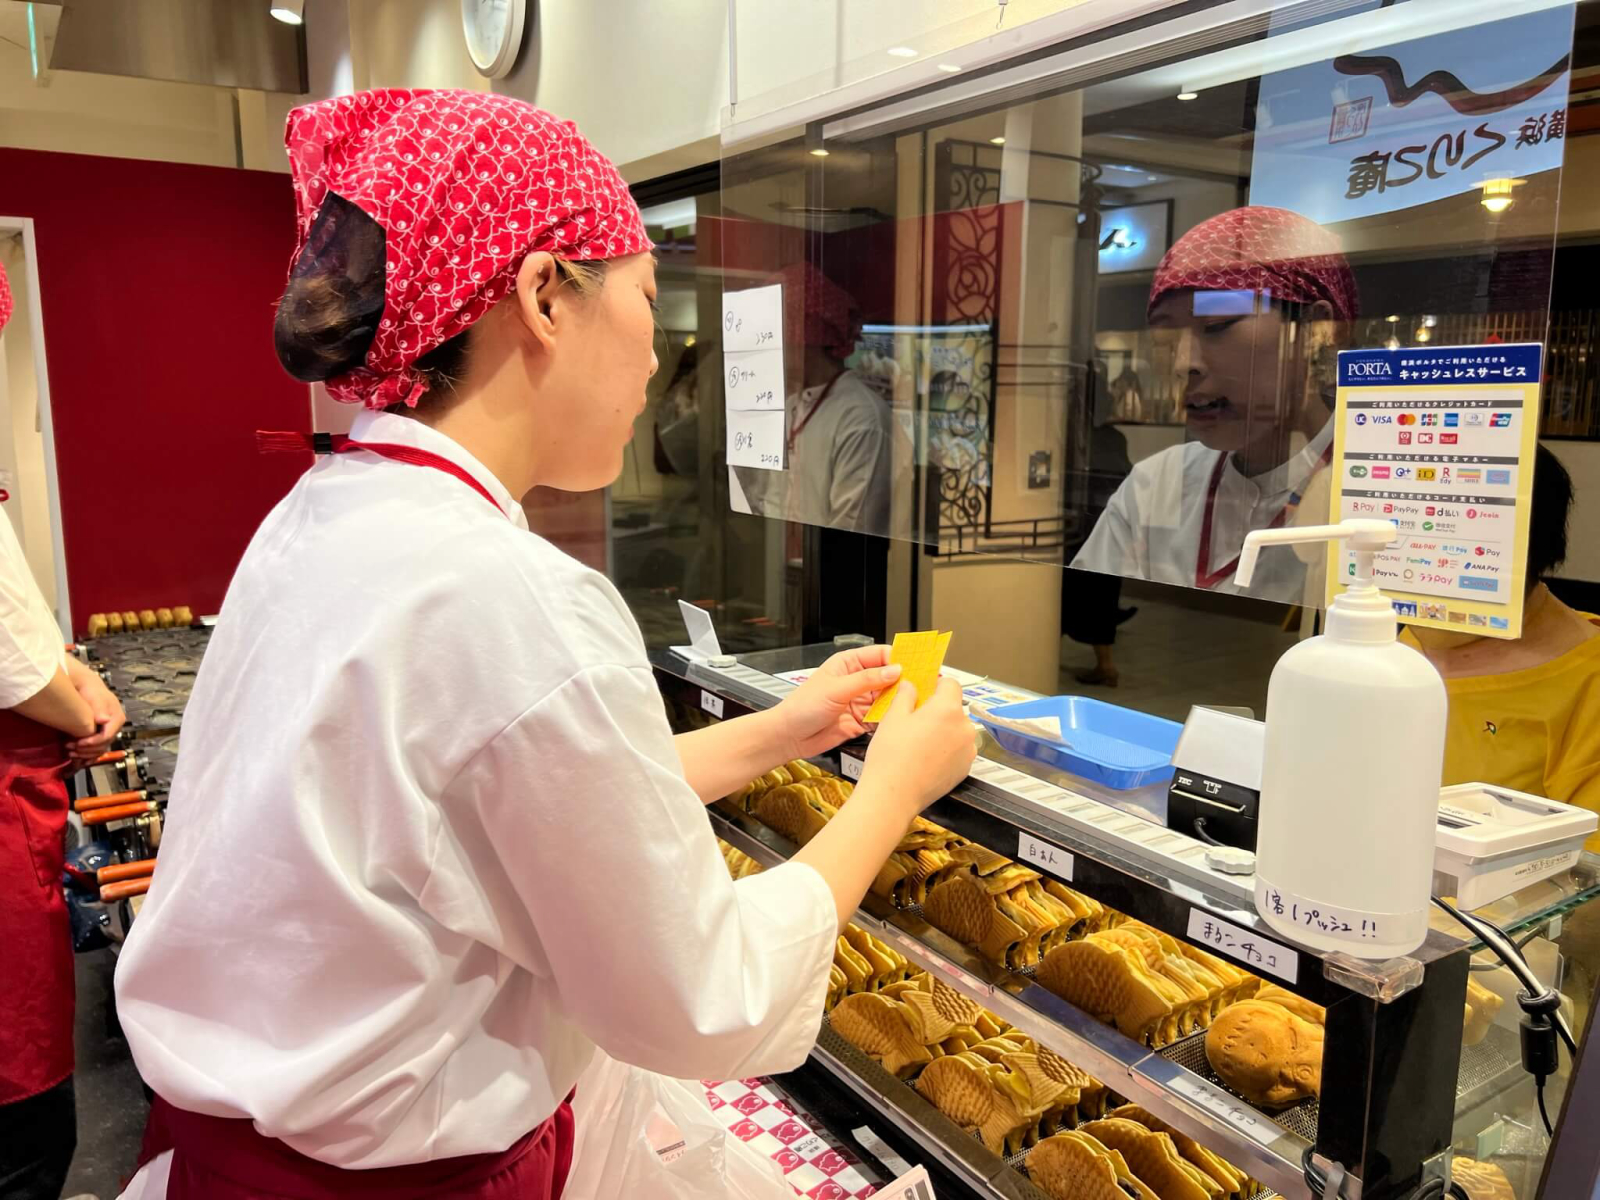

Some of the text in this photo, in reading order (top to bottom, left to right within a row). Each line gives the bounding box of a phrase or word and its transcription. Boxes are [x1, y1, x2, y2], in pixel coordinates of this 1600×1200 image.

[1348, 361, 1392, 376] PORTA
[1399, 366, 1527, 380] キャッシュレスサービス
[1372, 415, 1393, 424] VISA
[1360, 502, 1375, 512] Pay
[1393, 505, 1419, 515] PayPay
[1437, 507, 1459, 517] d払い
[1486, 549, 1500, 557] Pay
[1487, 564, 1500, 573] Pay
[1029, 843, 1058, 865] 白あん
